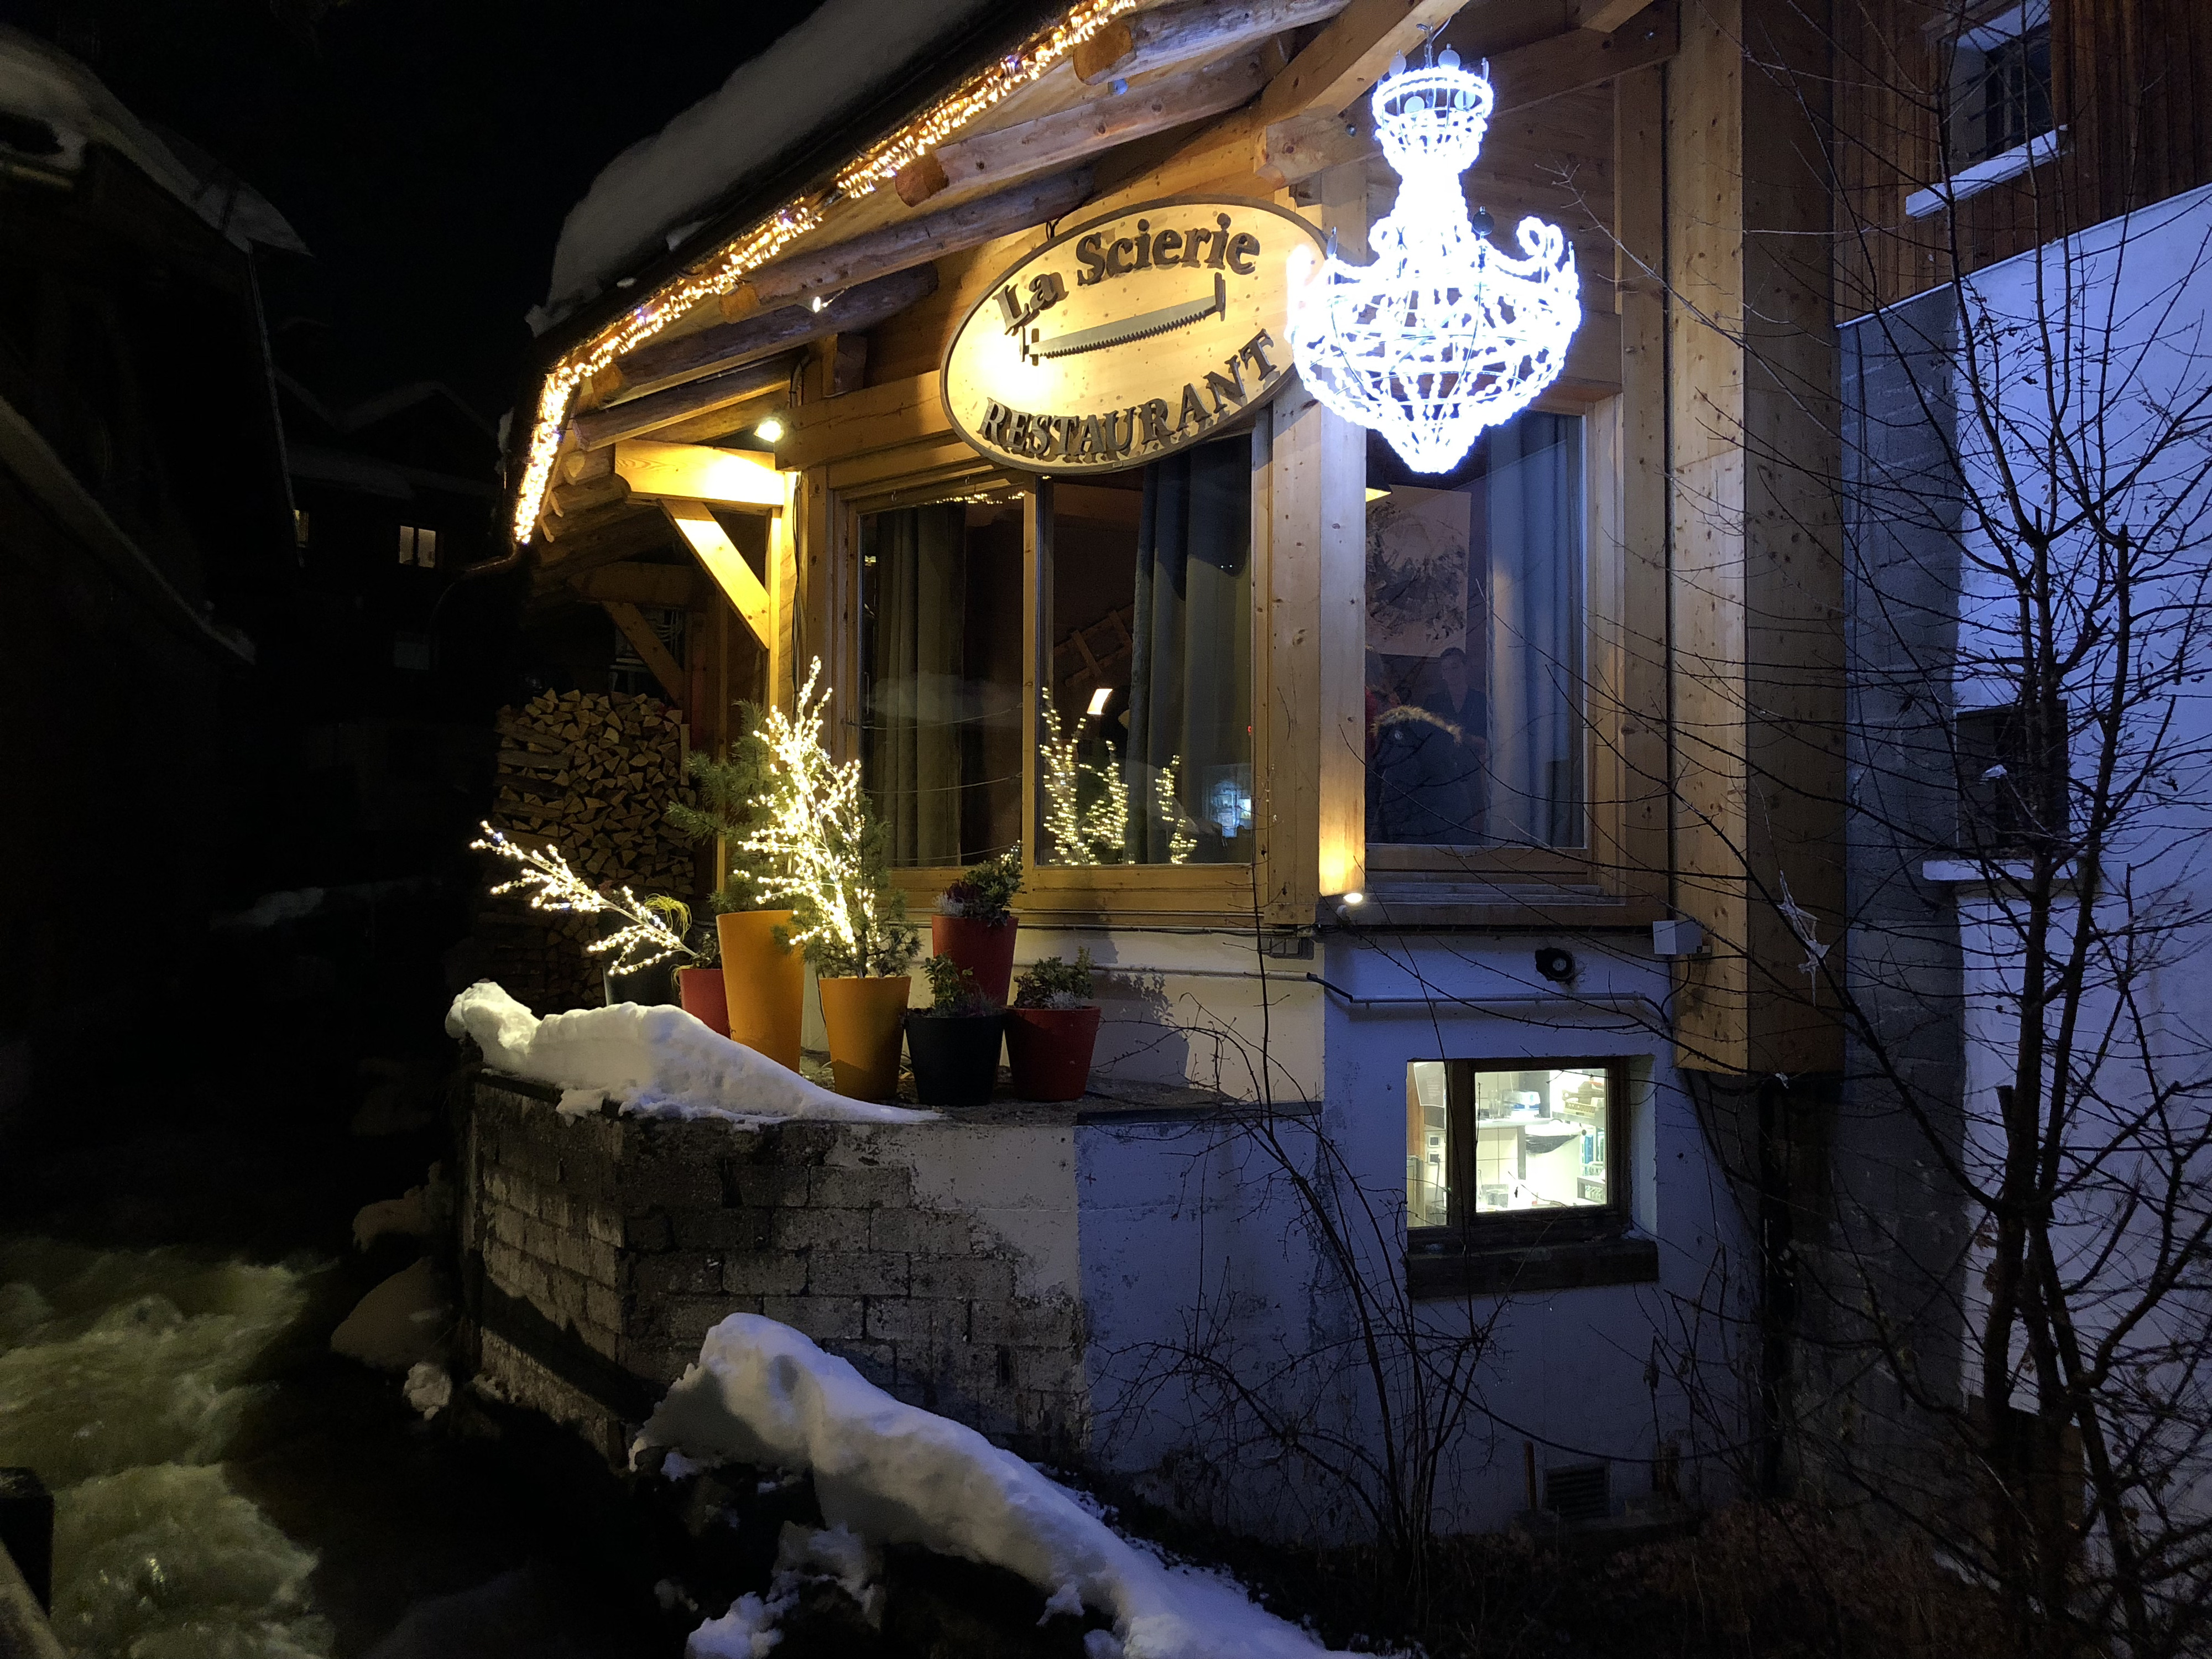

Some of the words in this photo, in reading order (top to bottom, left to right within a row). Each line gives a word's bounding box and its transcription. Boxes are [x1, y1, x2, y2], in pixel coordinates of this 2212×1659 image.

[993, 271, 1069, 332] La
[1075, 212, 1260, 286] Scierie
[977, 328, 1277, 458] RESTAURANT
